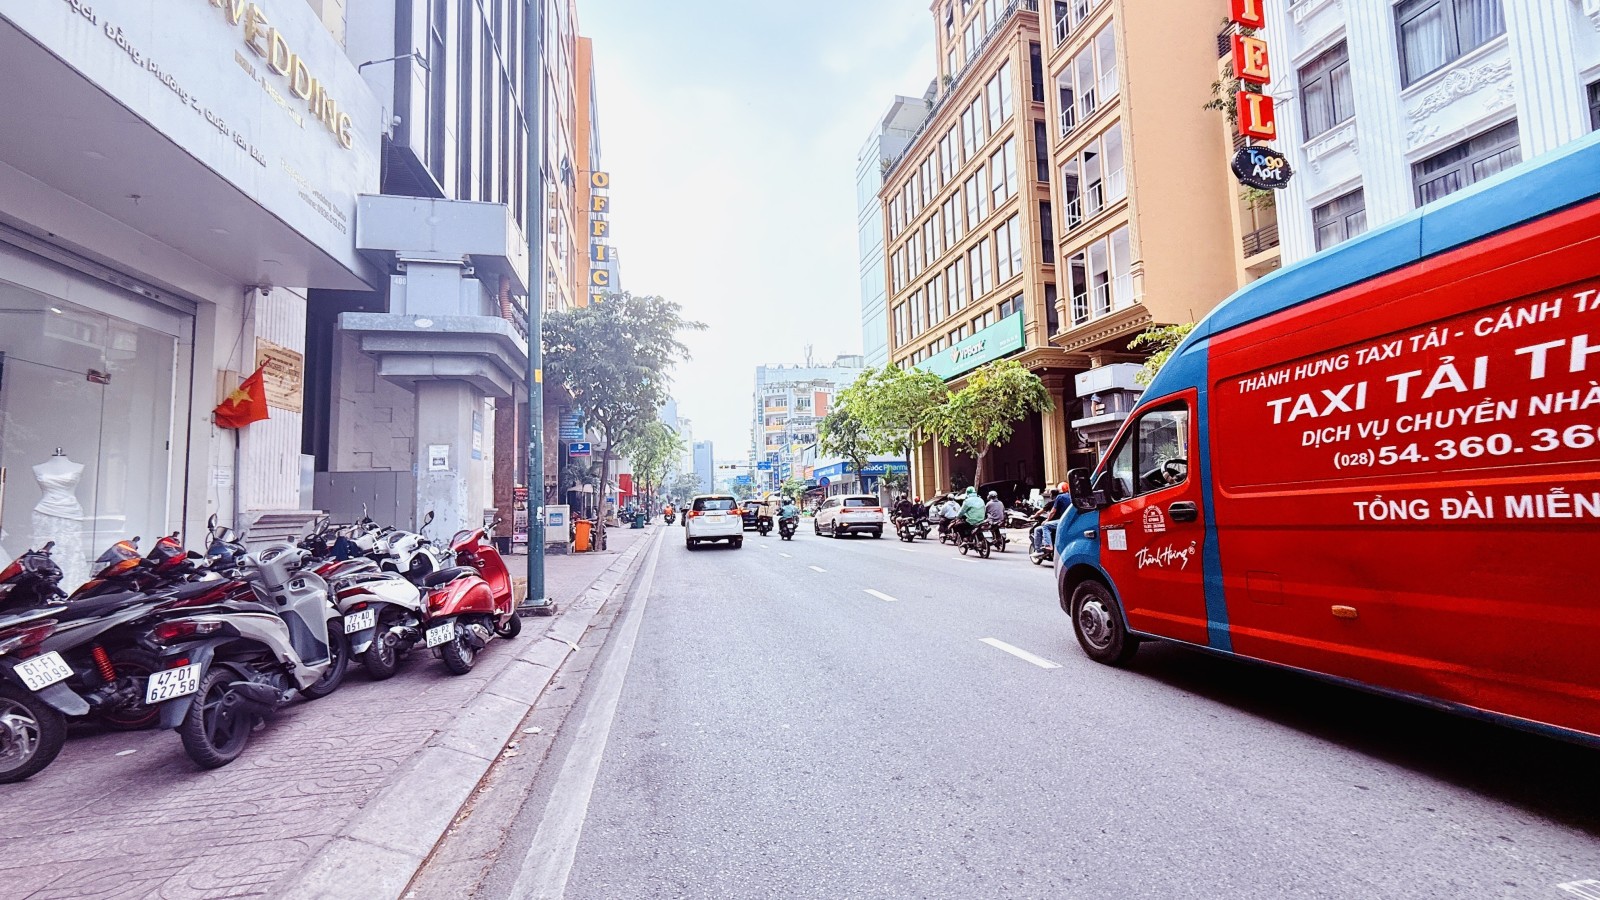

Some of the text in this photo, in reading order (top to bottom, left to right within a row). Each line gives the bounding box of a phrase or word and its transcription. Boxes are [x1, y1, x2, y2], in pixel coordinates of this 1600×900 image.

[1238, 369, 1291, 394] THÀNH
[1294, 354, 1350, 381] HƯNG
[1355, 339, 1403, 366] TAXI
[1409, 326, 1449, 353] TẢI
[1474, 298, 1563, 337] CÁNH
[1266, 381, 1368, 425] TAXI
[1386, 355, 1489, 403] TẢI
[1301, 424, 1351, 449] DỊCH
[1357, 418, 1390, 441] VỤ
[1396, 397, 1518, 434] CHUYỂN
[1352, 487, 1600, 520] TỔNG ĐÀI MIỄN
[23, 656, 56, 676] 61-F1
[158, 667, 191, 685] 47-D1
[151, 679, 195, 701] 627.58
